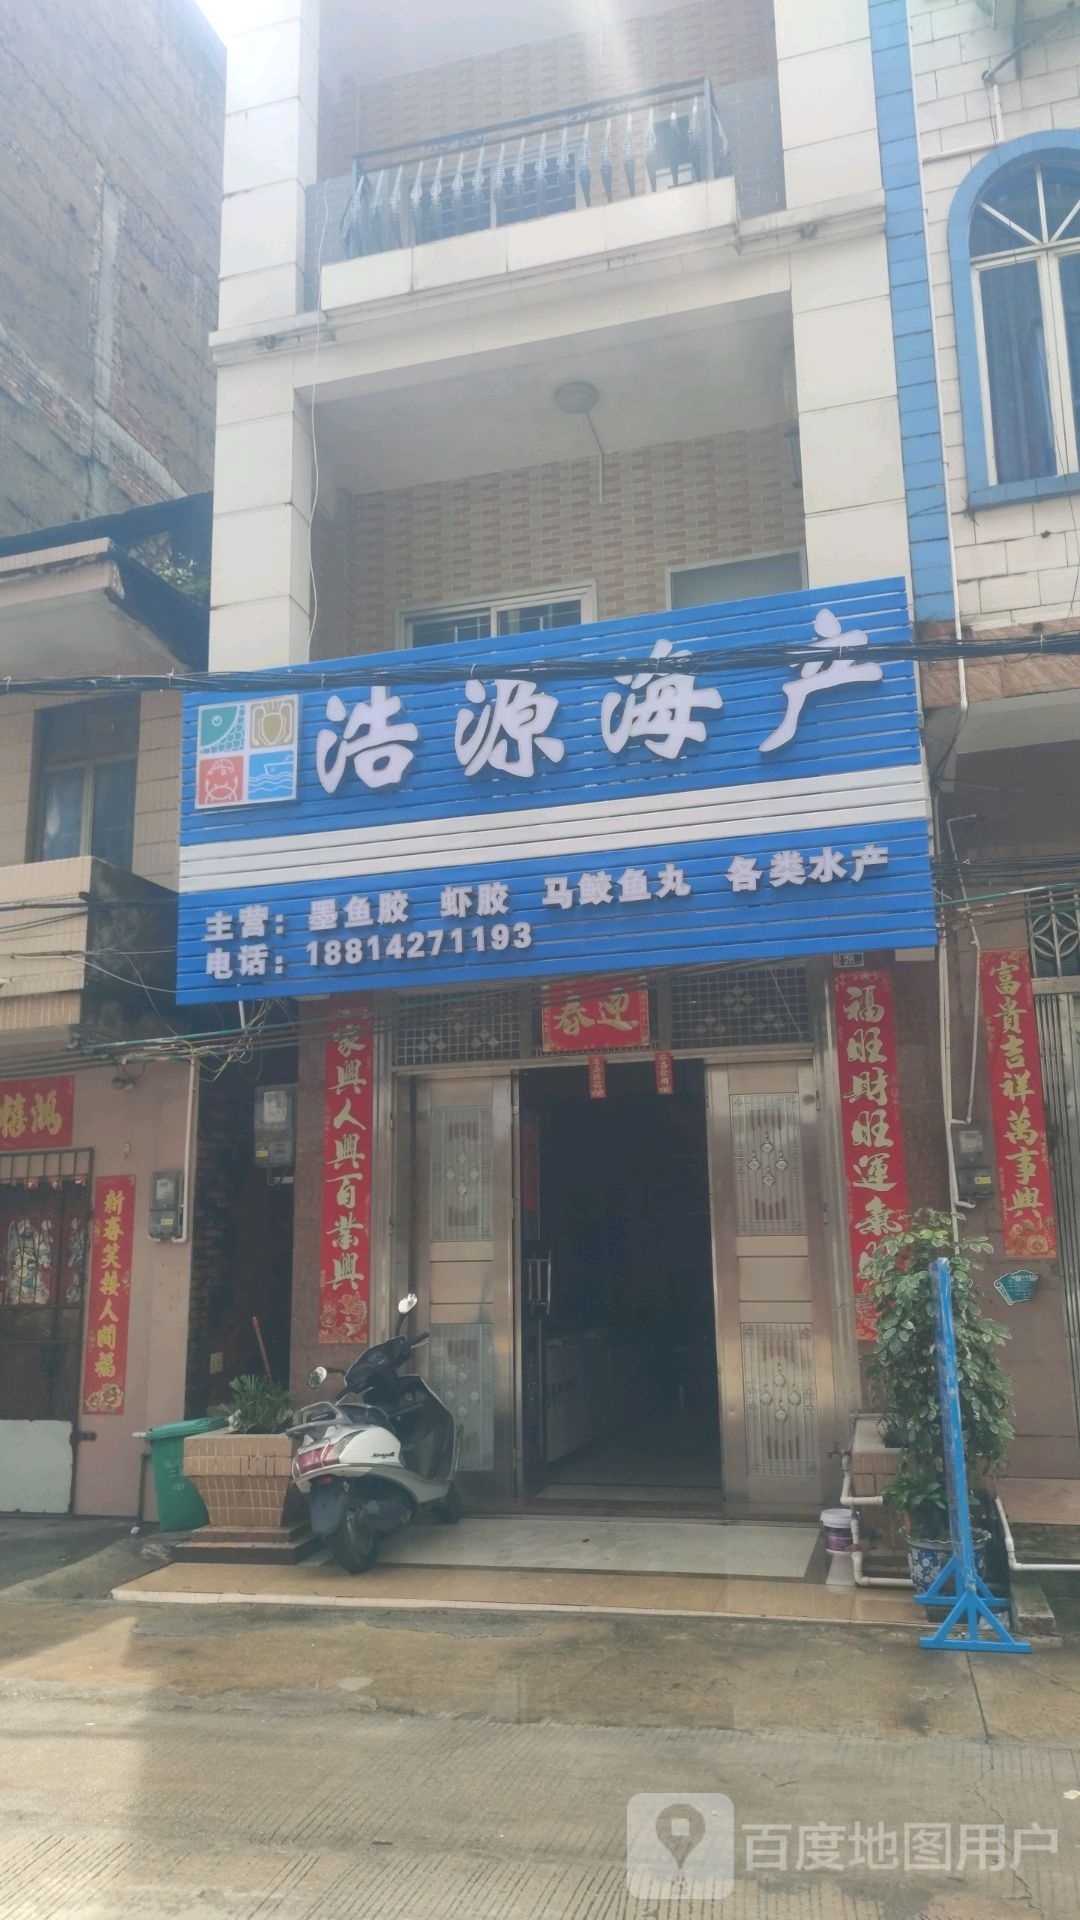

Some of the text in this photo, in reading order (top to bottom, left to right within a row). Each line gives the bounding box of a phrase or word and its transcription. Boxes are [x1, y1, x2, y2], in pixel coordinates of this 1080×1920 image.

[316, 608, 883, 794] 浩源海产
[306, 922, 532, 966] 18814271193
[307, 891, 409, 932] 墨鱼胶
[440, 882, 510, 918] 虾胶
[542, 863, 692, 909] 马鲛鱼丸
[725, 843, 889, 893] 各类水产
[843, 985, 903, 1282] 福旺財旺運氣
